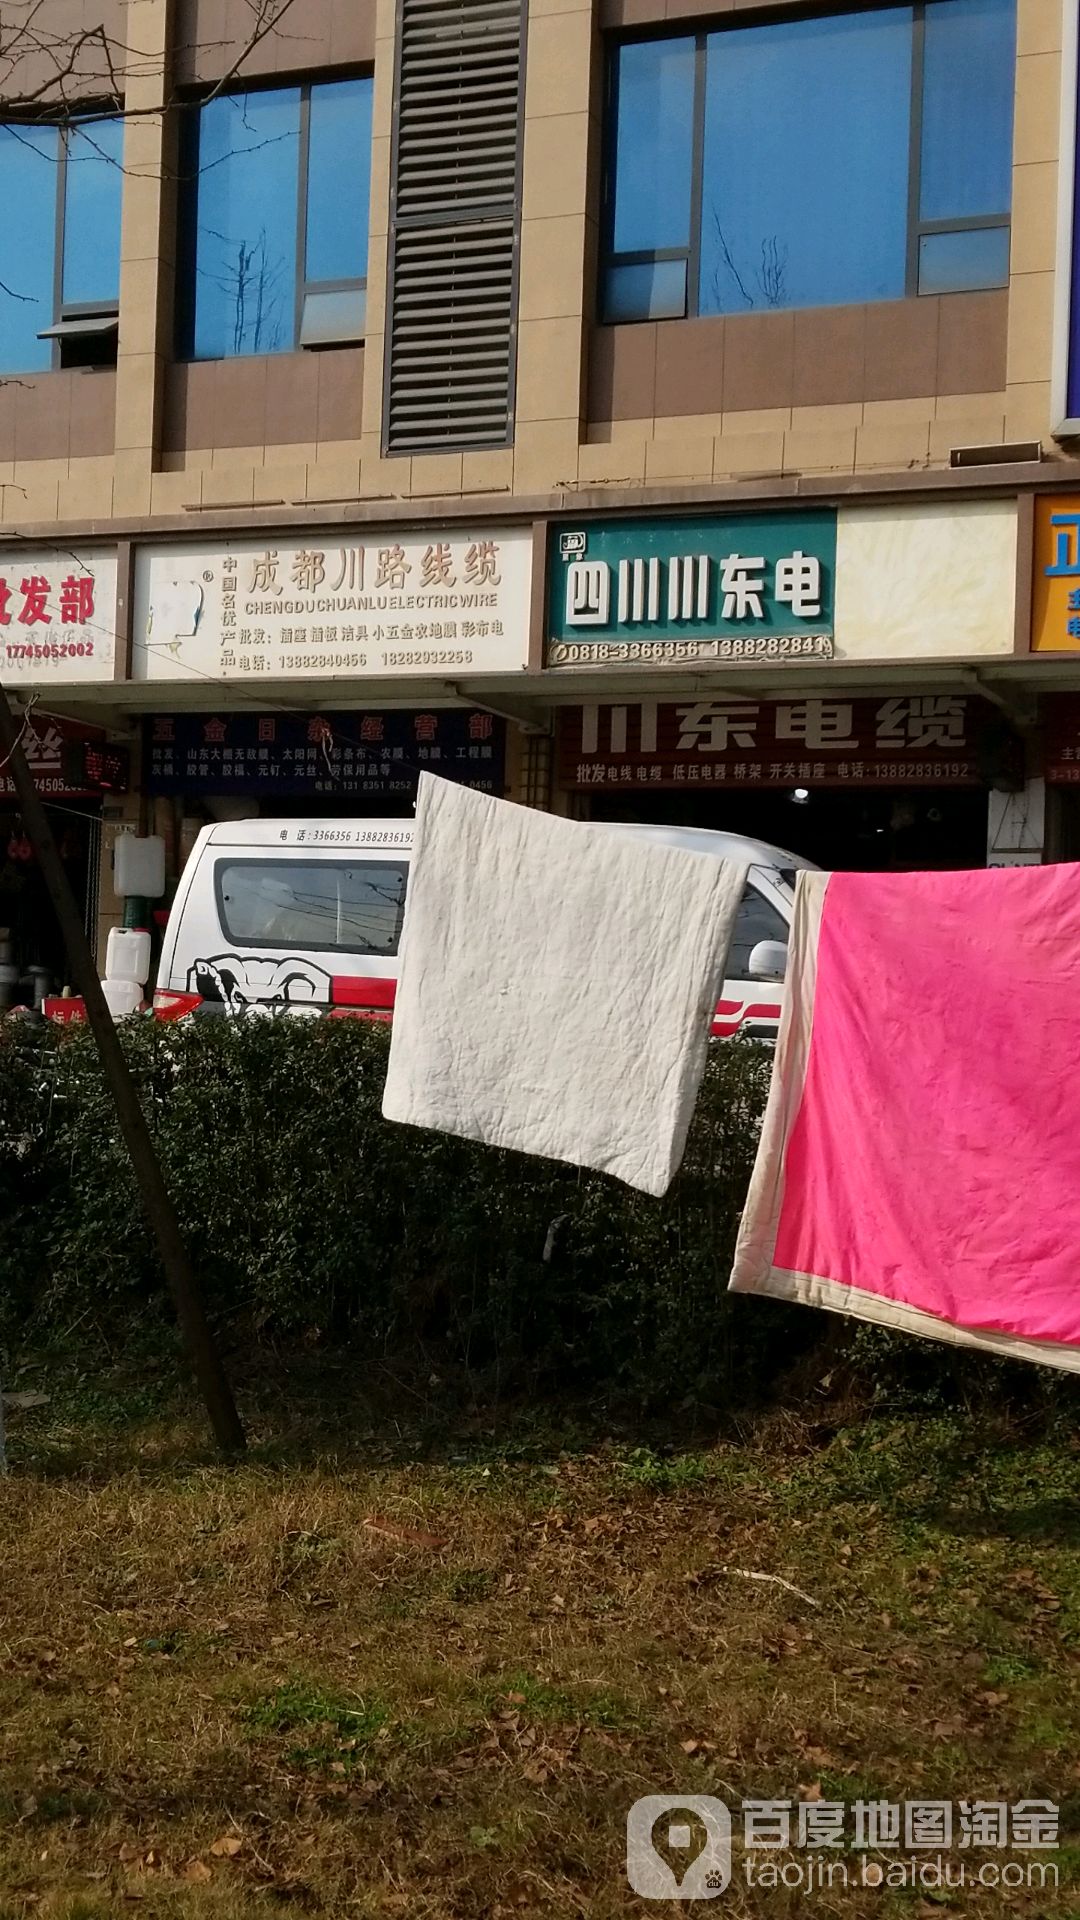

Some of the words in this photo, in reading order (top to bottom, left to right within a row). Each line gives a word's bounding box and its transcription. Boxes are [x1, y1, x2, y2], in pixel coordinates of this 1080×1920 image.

[247, 541, 502, 596] 成都川路线缆
[566, 550, 822, 625] 四川川东电
[220, 557, 238, 668] 中国名优产品
[6, 642, 95, 659] 17745052002
[569, 640, 699, 660] 0818-3366356
[581, 699, 967, 754] 川东电缆
